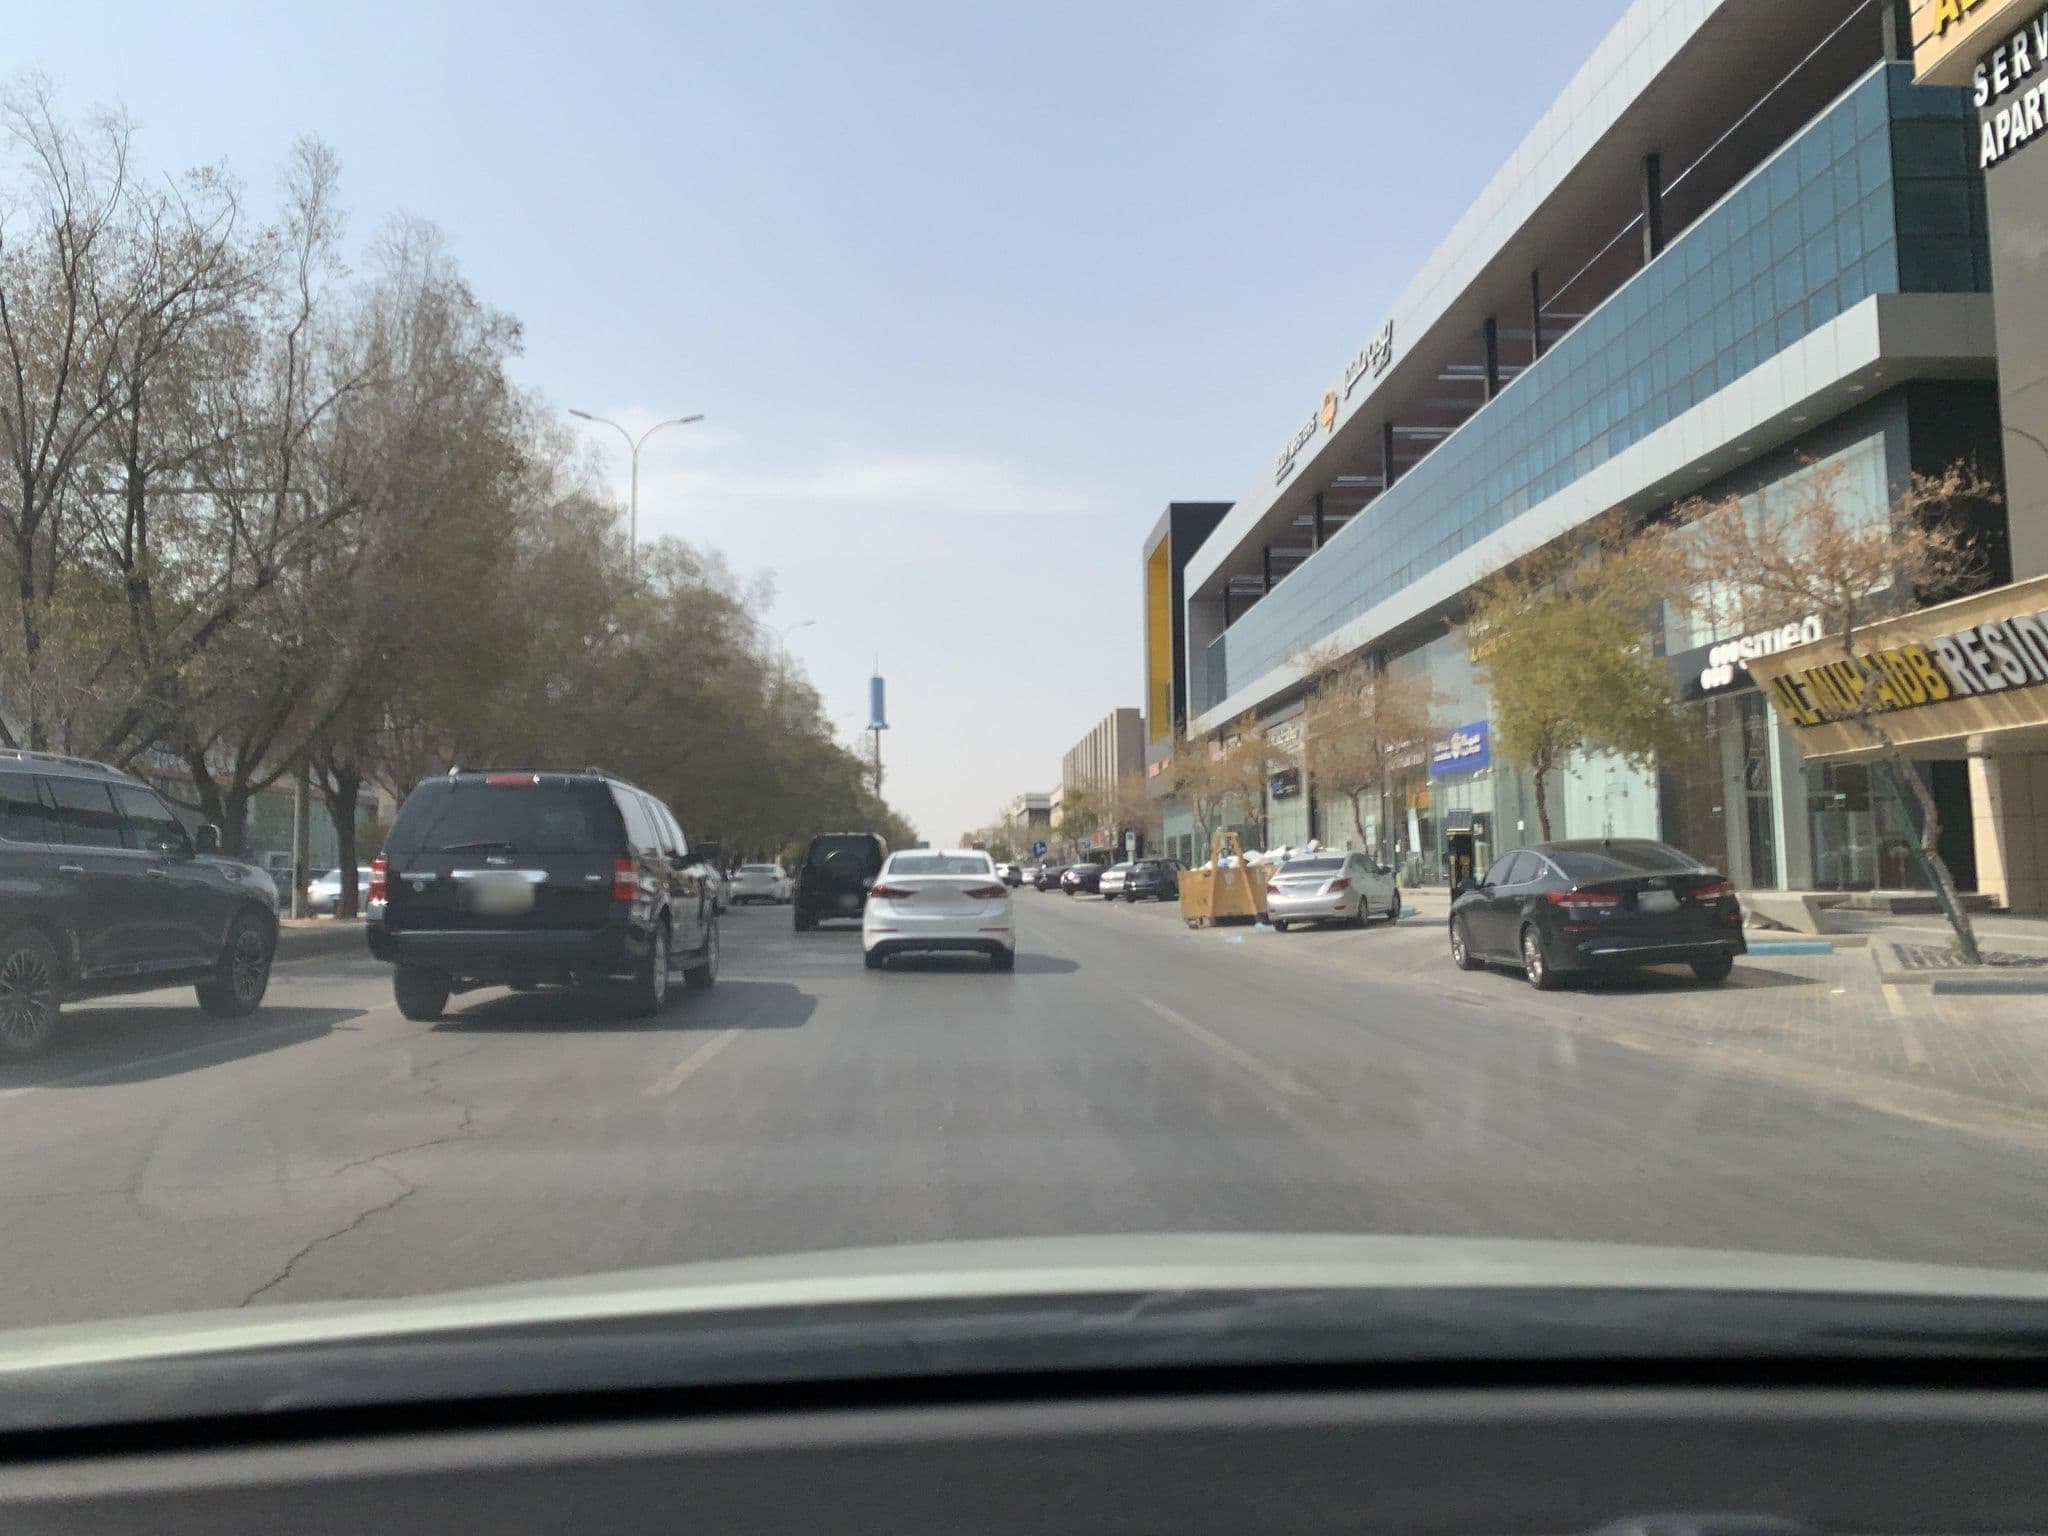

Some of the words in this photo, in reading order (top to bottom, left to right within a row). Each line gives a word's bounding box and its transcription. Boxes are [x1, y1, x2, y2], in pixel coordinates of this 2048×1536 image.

[1934, 0, 1977, 34] A
[1973, 11, 2048, 107] SERV
[1934, 611, 2048, 695] RESID
